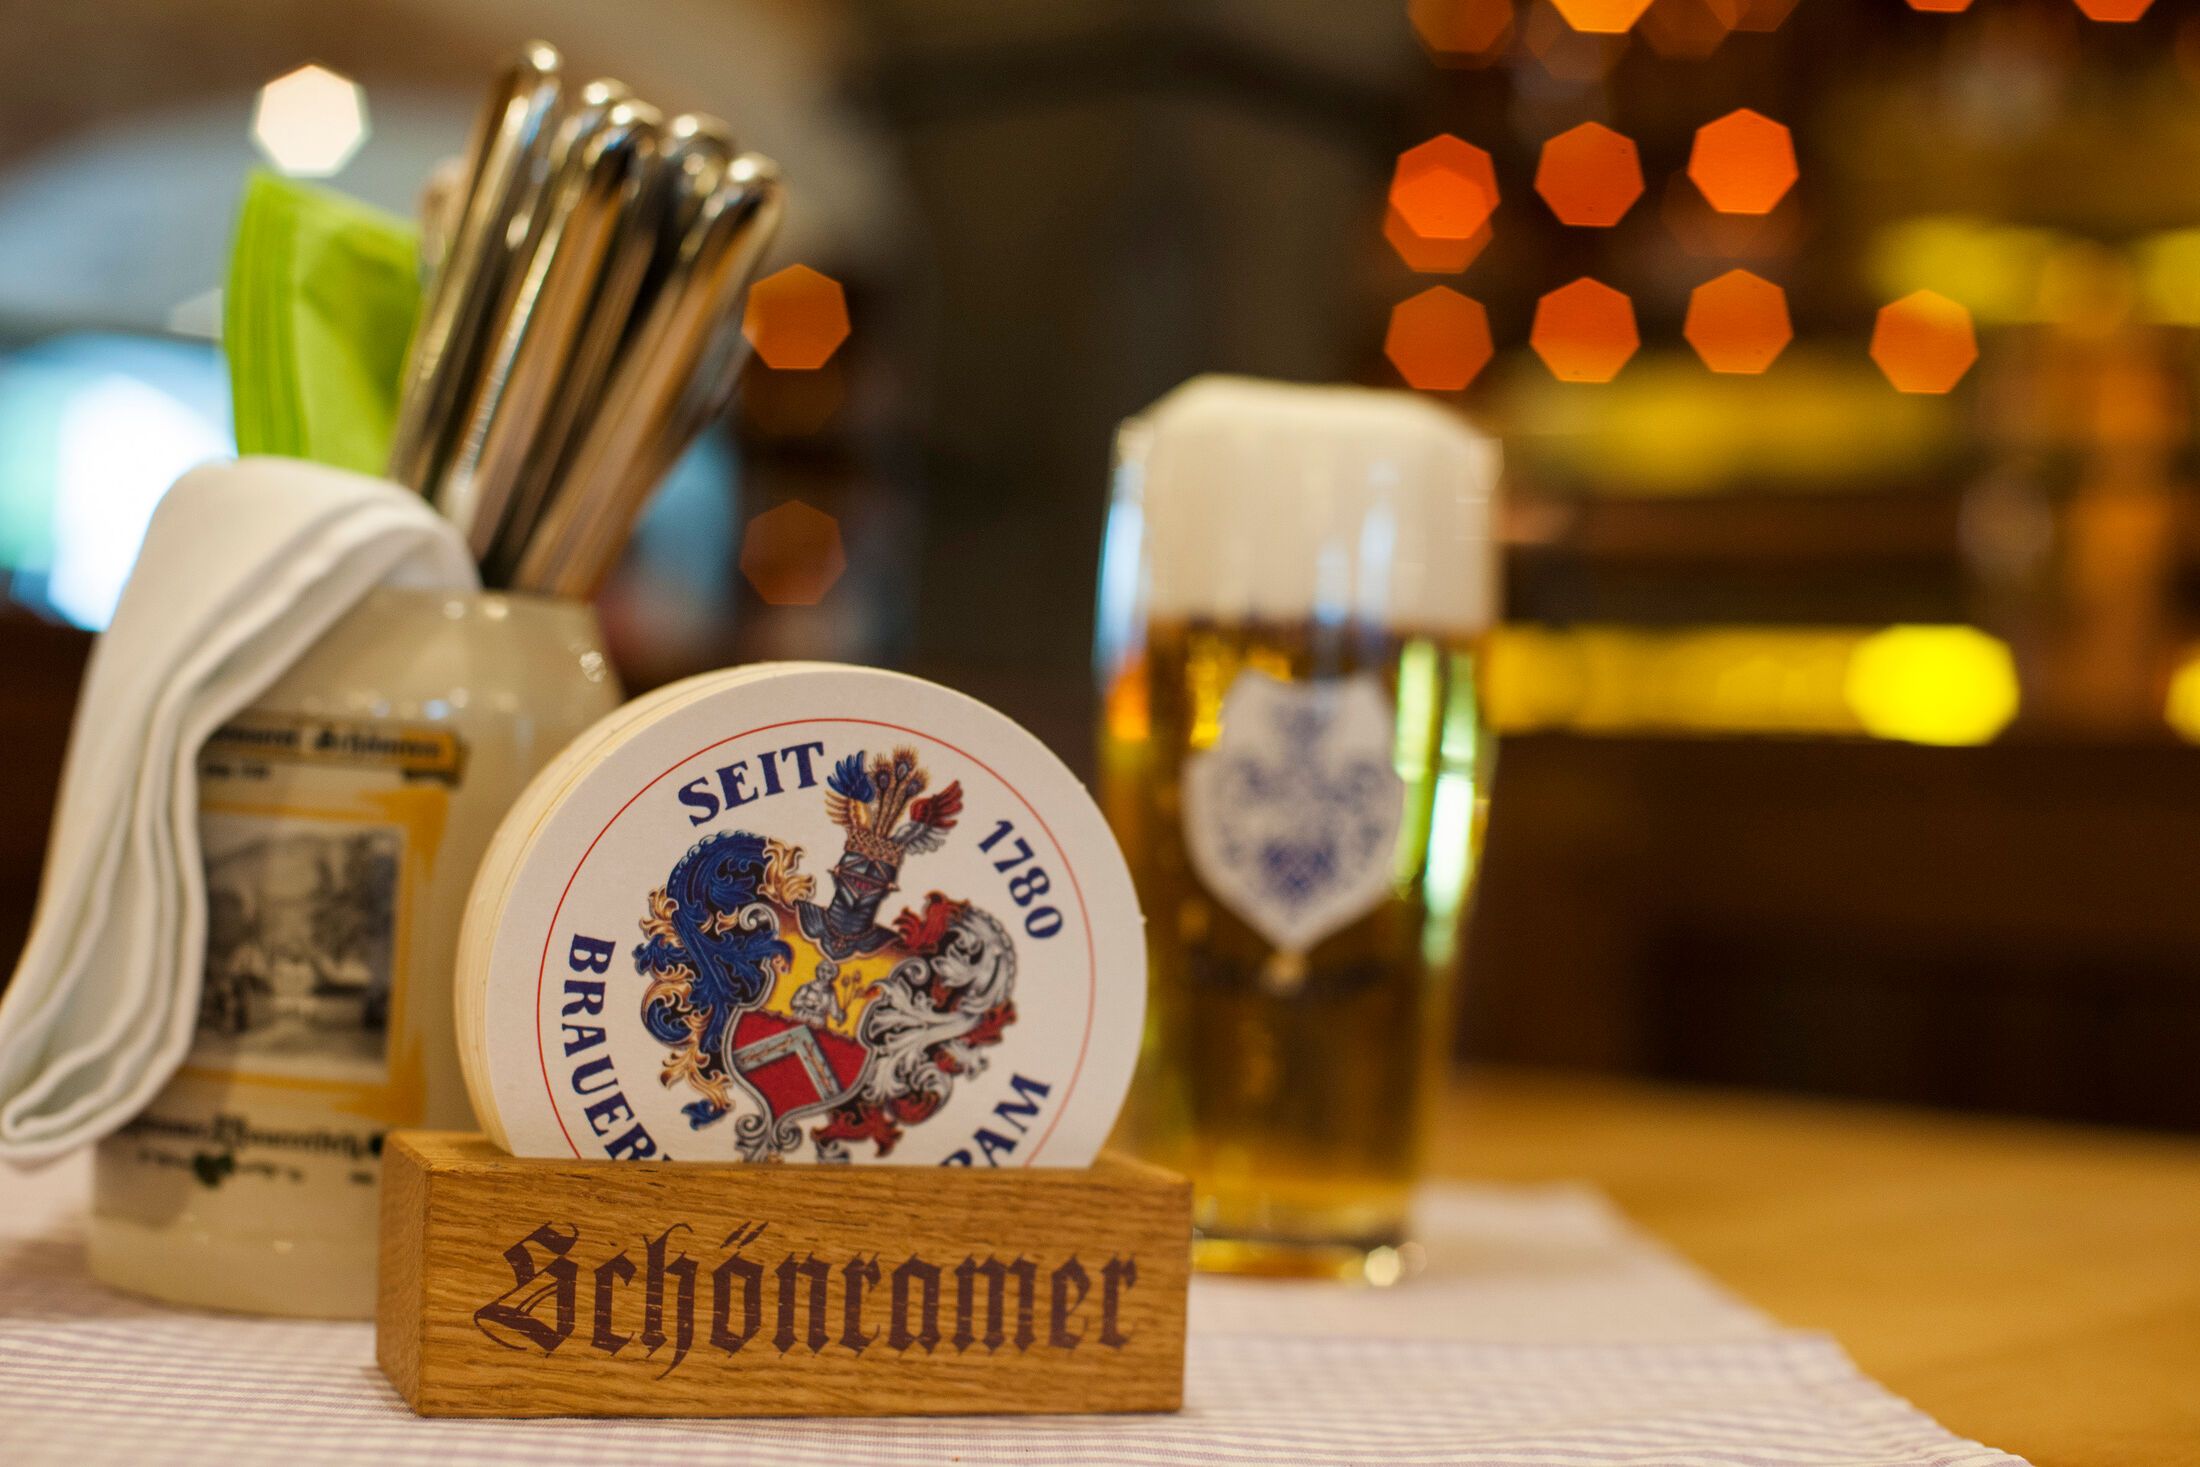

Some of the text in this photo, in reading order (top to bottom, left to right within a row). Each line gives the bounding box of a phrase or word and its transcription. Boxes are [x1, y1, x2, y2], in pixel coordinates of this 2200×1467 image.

[677, 741, 1064, 940] SEIT 1780
[562, 933, 672, 1162] BRAUER
[473, 1219, 1139, 1381] Schönramer
